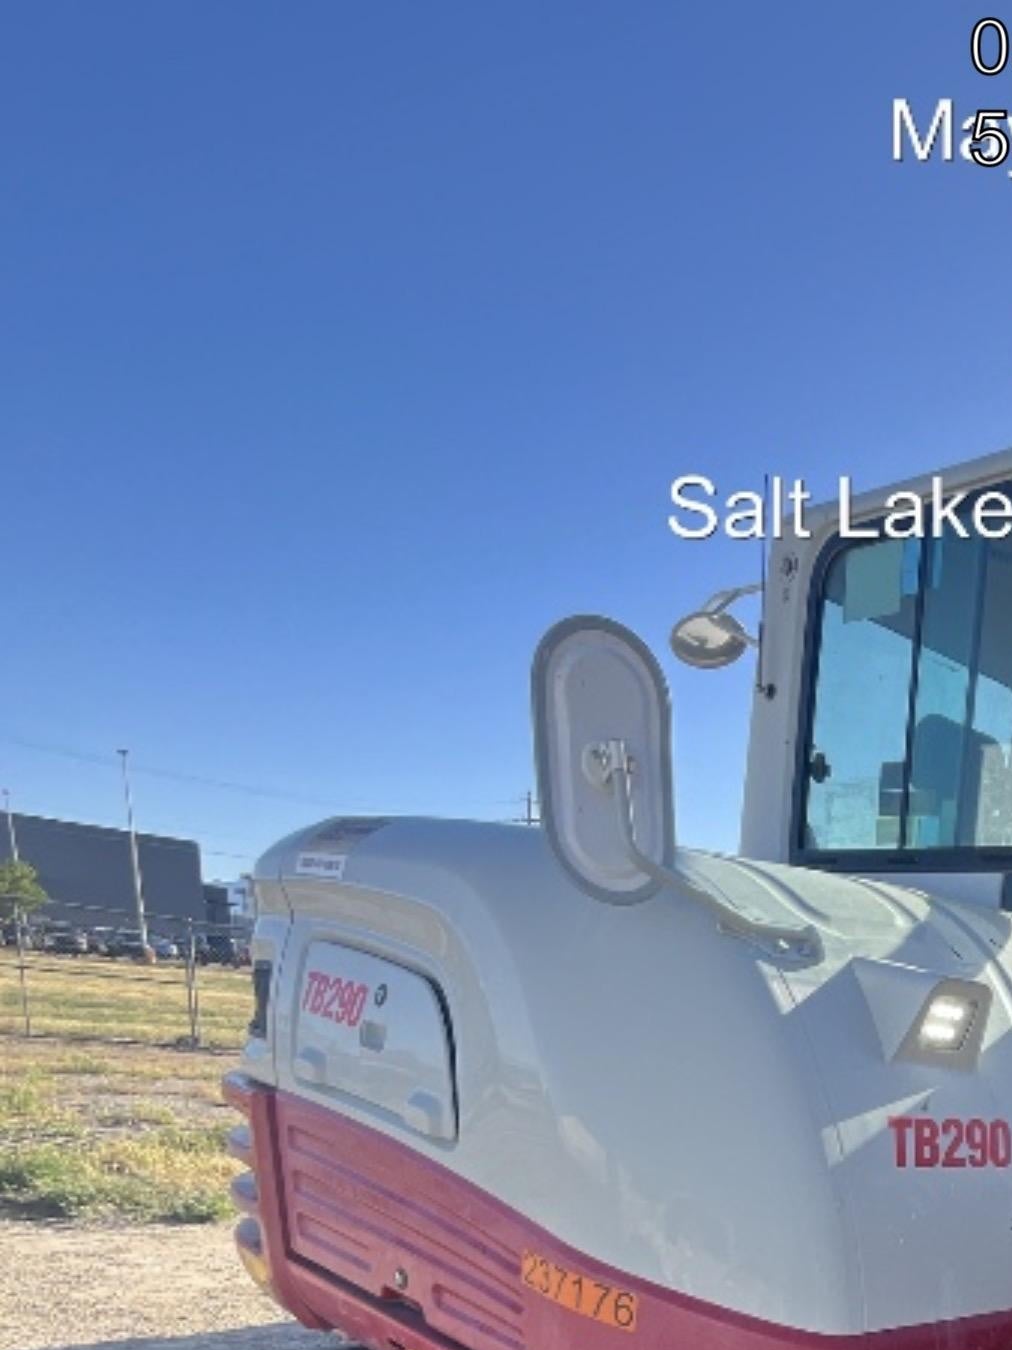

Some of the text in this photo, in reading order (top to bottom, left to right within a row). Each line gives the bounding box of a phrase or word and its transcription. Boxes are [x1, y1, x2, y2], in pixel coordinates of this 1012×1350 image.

[302, 971, 369, 1027] TB290
[887, 1116, 1012, 1168] TB290
[524, 1251, 634, 1327] 237176
